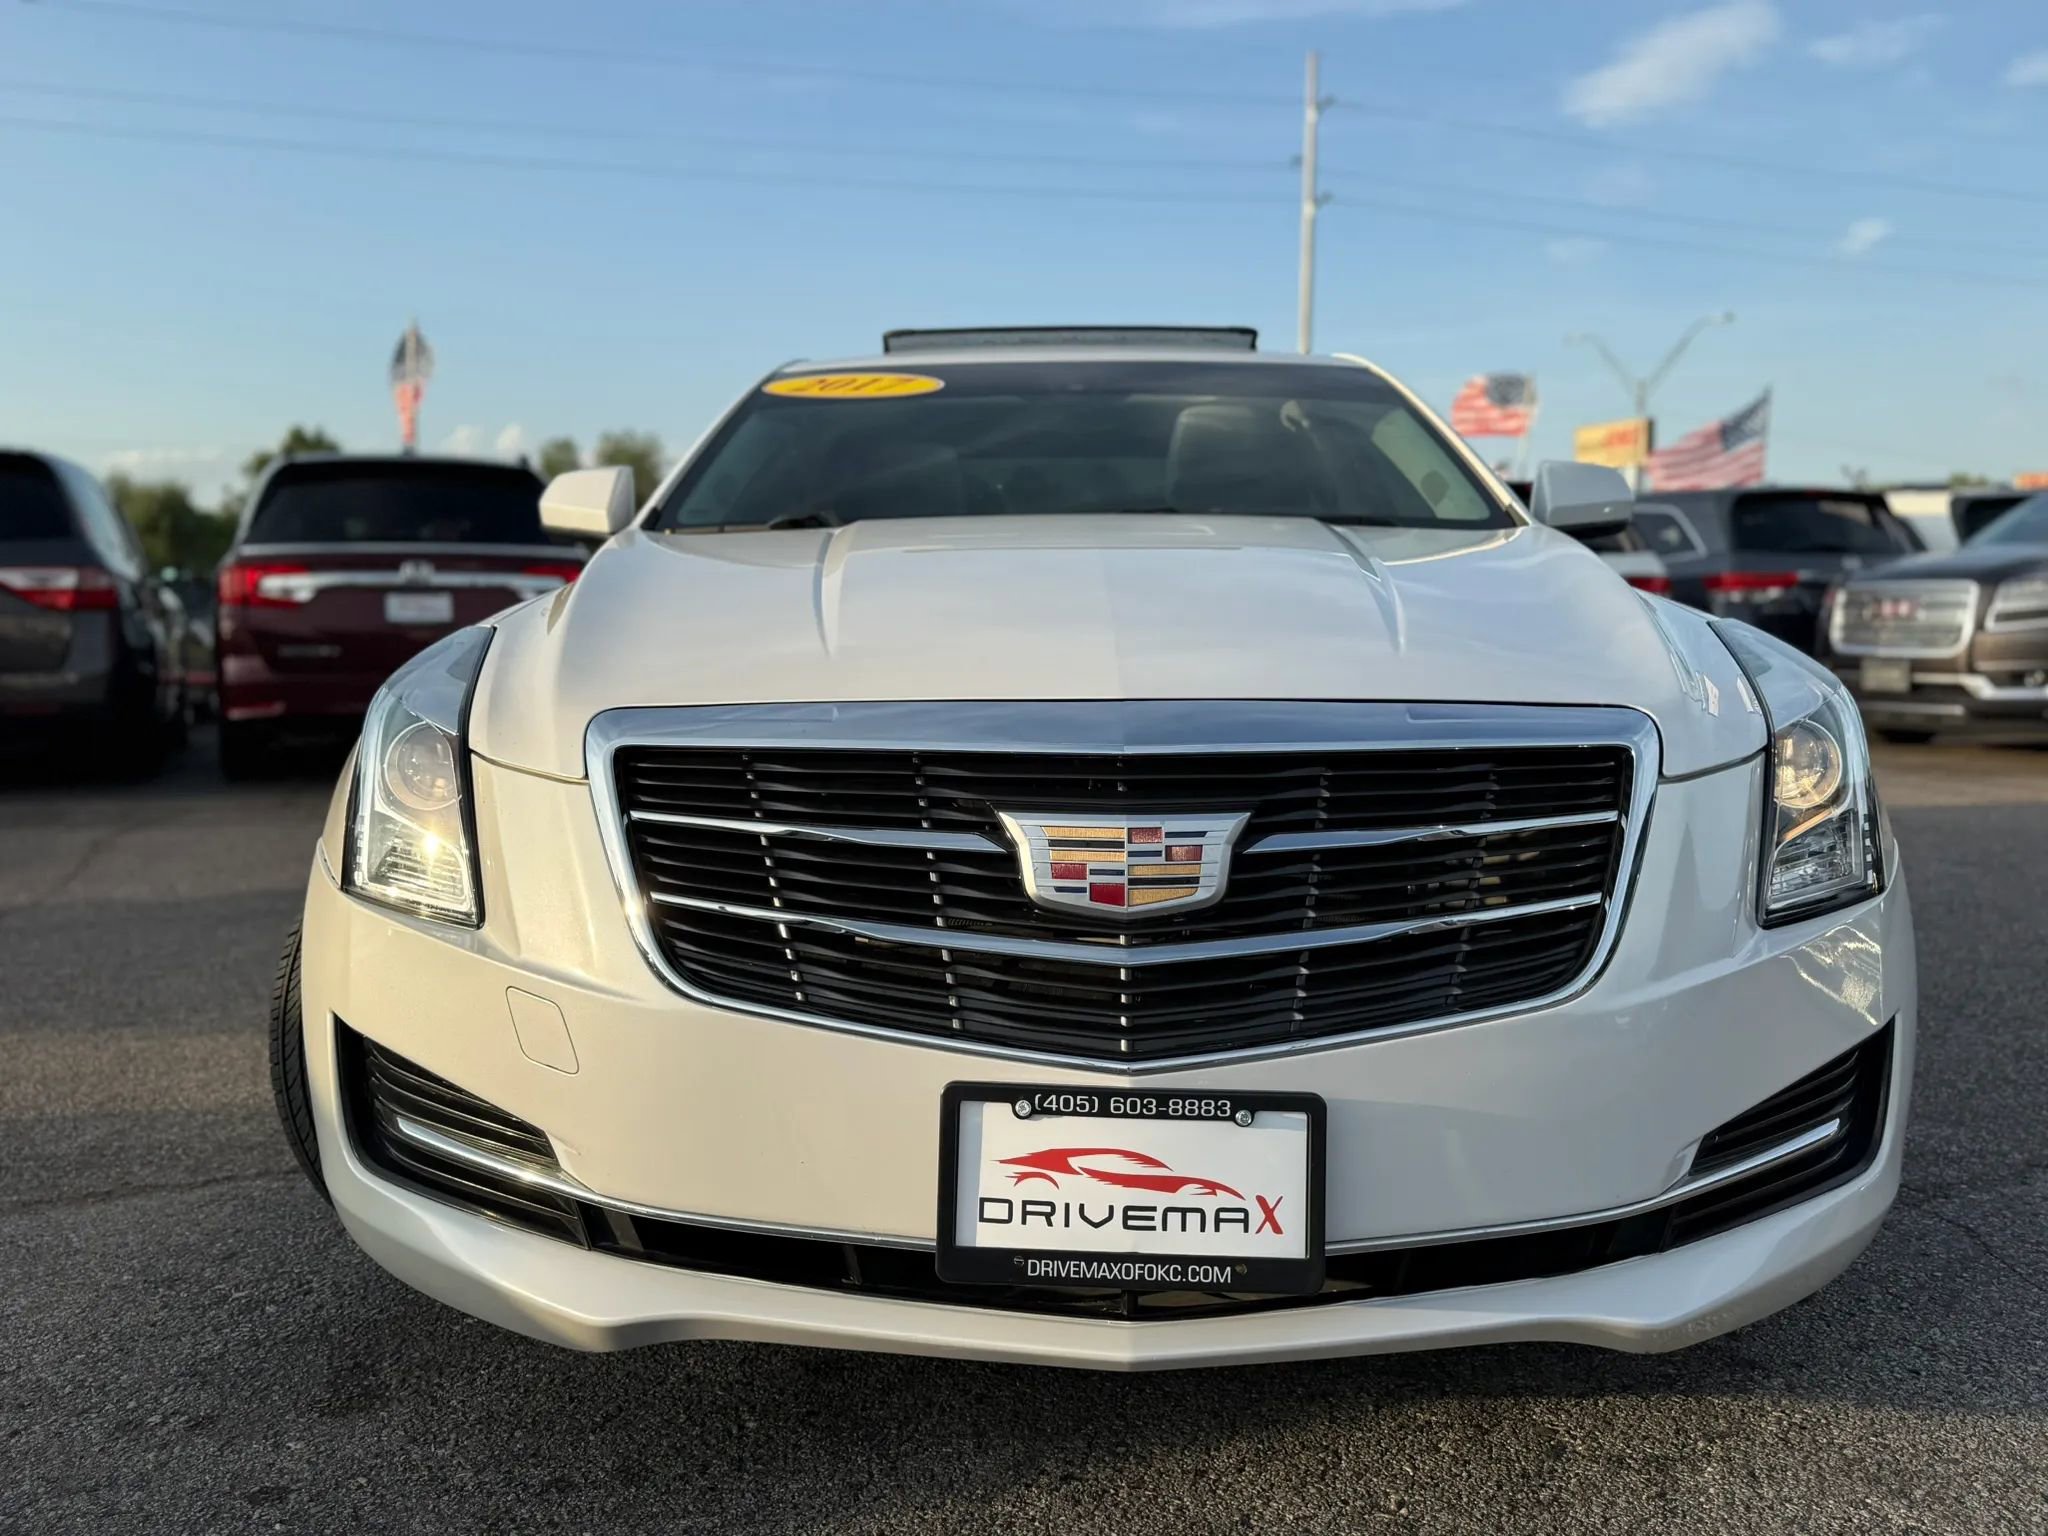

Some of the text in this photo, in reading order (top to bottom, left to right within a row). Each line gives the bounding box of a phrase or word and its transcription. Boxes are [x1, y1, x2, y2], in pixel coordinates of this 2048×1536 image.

[786, 378, 918, 392] 2017
[1034, 1093, 1231, 1117] (405) 603-8883
[978, 1195, 1284, 1235] DRIVEMAX
[1027, 1258, 1232, 1284] DRIVEMAXOFOKC.COM
